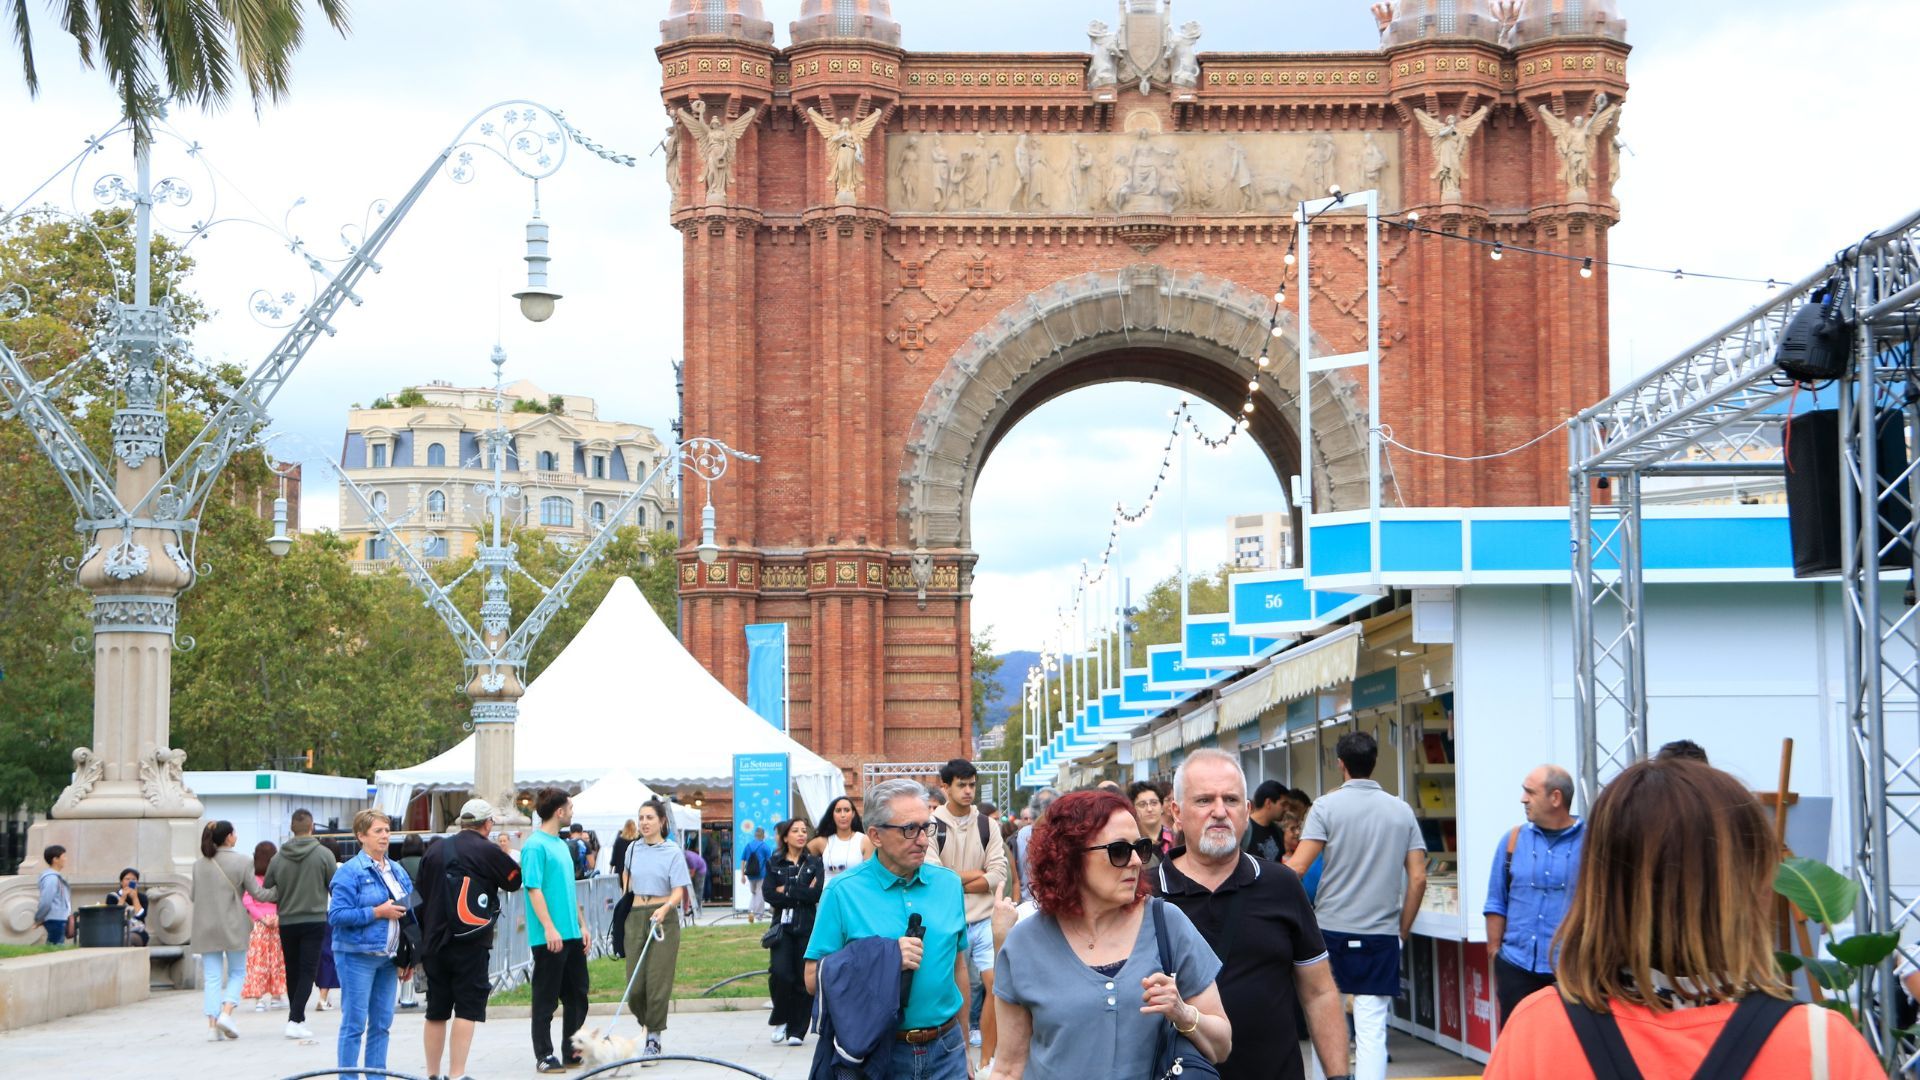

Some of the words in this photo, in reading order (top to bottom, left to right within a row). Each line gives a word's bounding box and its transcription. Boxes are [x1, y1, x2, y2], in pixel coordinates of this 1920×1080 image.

[1265, 593, 1283, 609] 56
[1211, 633, 1226, 646] 55
[1173, 661, 1185, 671] 5
[739, 760, 750, 769] La
[750, 760, 783, 769] Setmana
